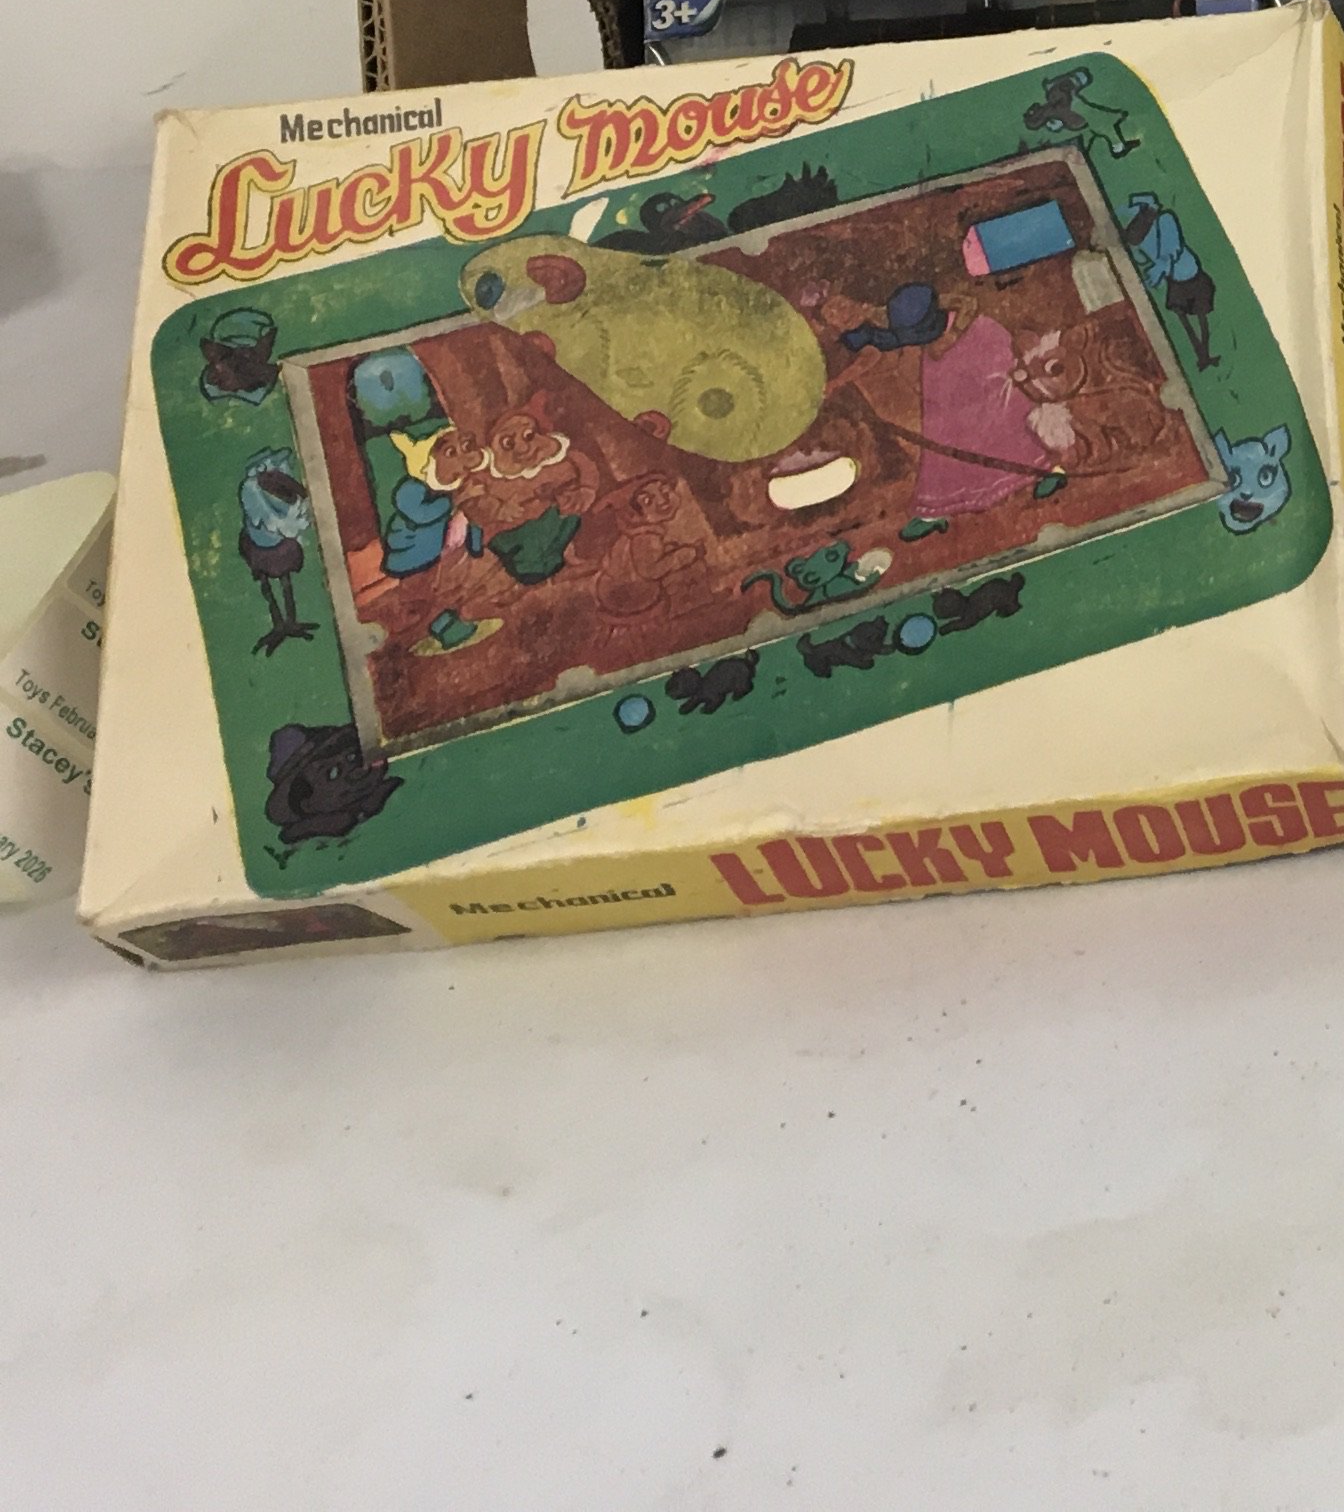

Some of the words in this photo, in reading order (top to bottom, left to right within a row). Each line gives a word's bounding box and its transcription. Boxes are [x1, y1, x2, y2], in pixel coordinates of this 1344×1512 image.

[279, 98, 443, 144] Mechanical
[85, 579, 107, 608] Toy
[15, 669, 50, 705] Toys
[49, 695, 97, 742] Februa
[451, 883, 676, 918] Mechanical
[710, 820, 1016, 907] LUCKY
